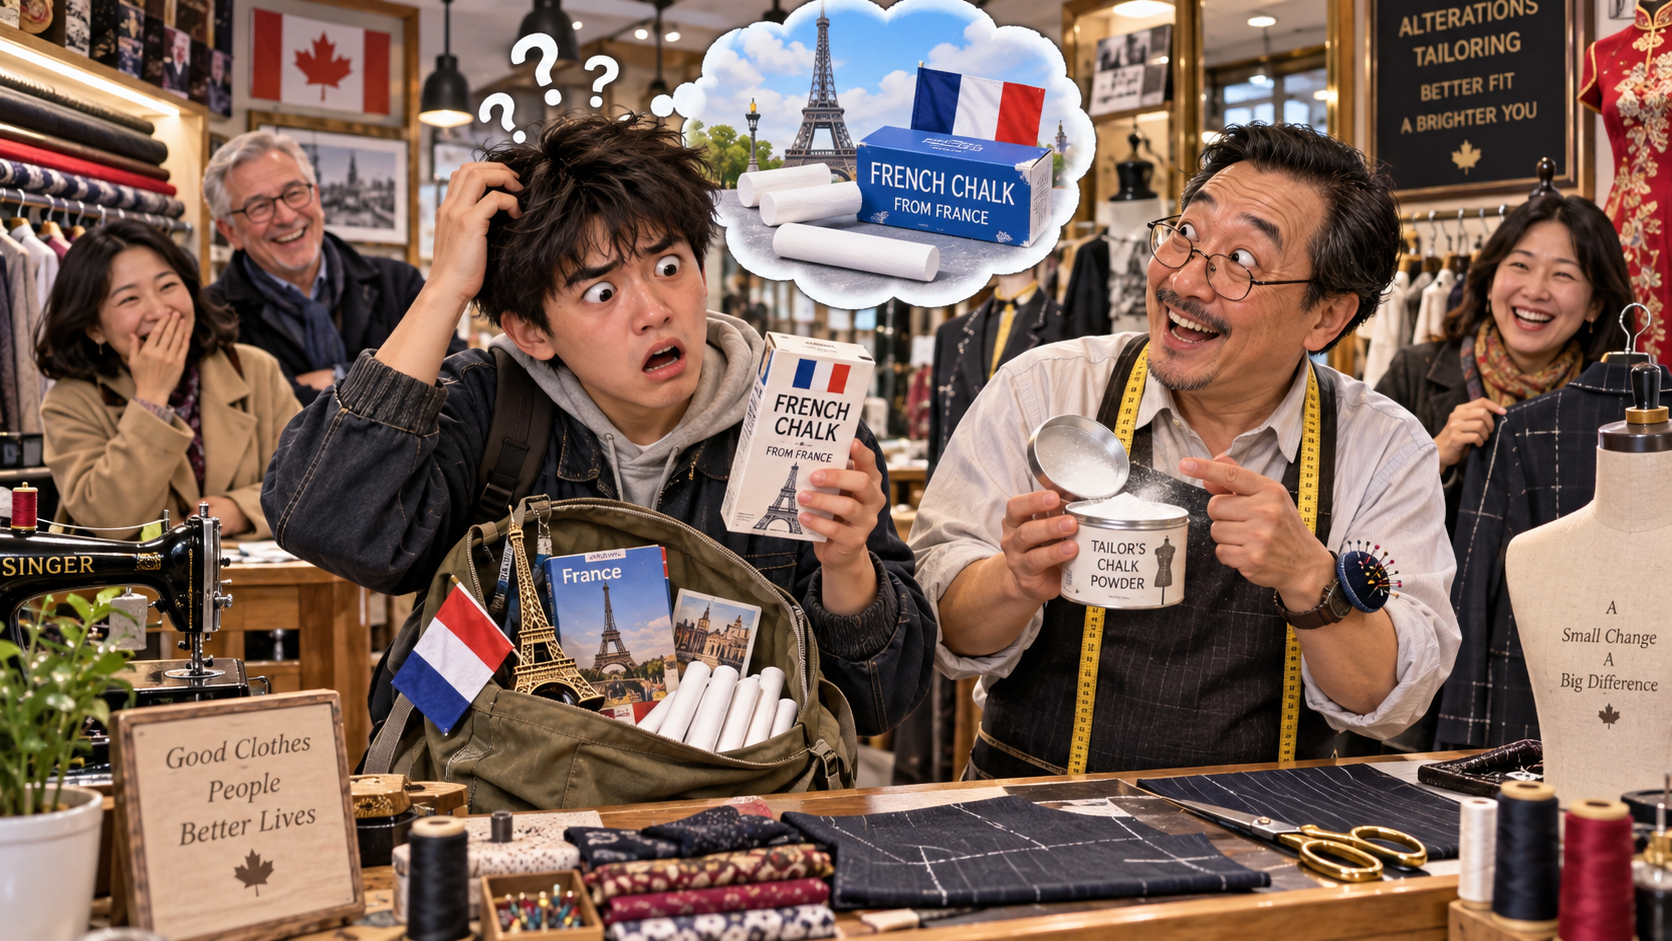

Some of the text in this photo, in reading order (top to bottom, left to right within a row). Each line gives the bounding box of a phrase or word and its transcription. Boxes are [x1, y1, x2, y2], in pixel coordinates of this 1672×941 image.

[1398, 0, 1539, 38] ALTERATIONS
[1413, 31, 1521, 67] TAILORING
[1420, 72, 1515, 102] BETTER FIT
[1400, 101, 1538, 134] A BRIGHTER YOU
[870, 162, 944, 194] FRENCH
[952, 174, 1015, 206] CHALK
[894, 196, 989, 226] FROM FRANCE
[774, 394, 850, 421] FRENCH
[774, 417, 840, 442] CHALK
[766, 446, 834, 463] FROM FRANCE
[1091, 540, 1146, 555] TAILOR'S
[2, 556, 95, 576] SINGER
[562, 566, 622, 584] France
[1097, 558, 1139, 572] CHALK
[1090, 574, 1145, 590] POWDER
[1606, 600, 1618, 614] A
[1562, 627, 1658, 649] Small Change
[1603, 652, 1614, 666] A
[1560, 672, 1658, 693] Big Difference
[166, 734, 311, 770] Good Clothes
[208, 772, 281, 804] People
[179, 807, 316, 846] Better Lives
